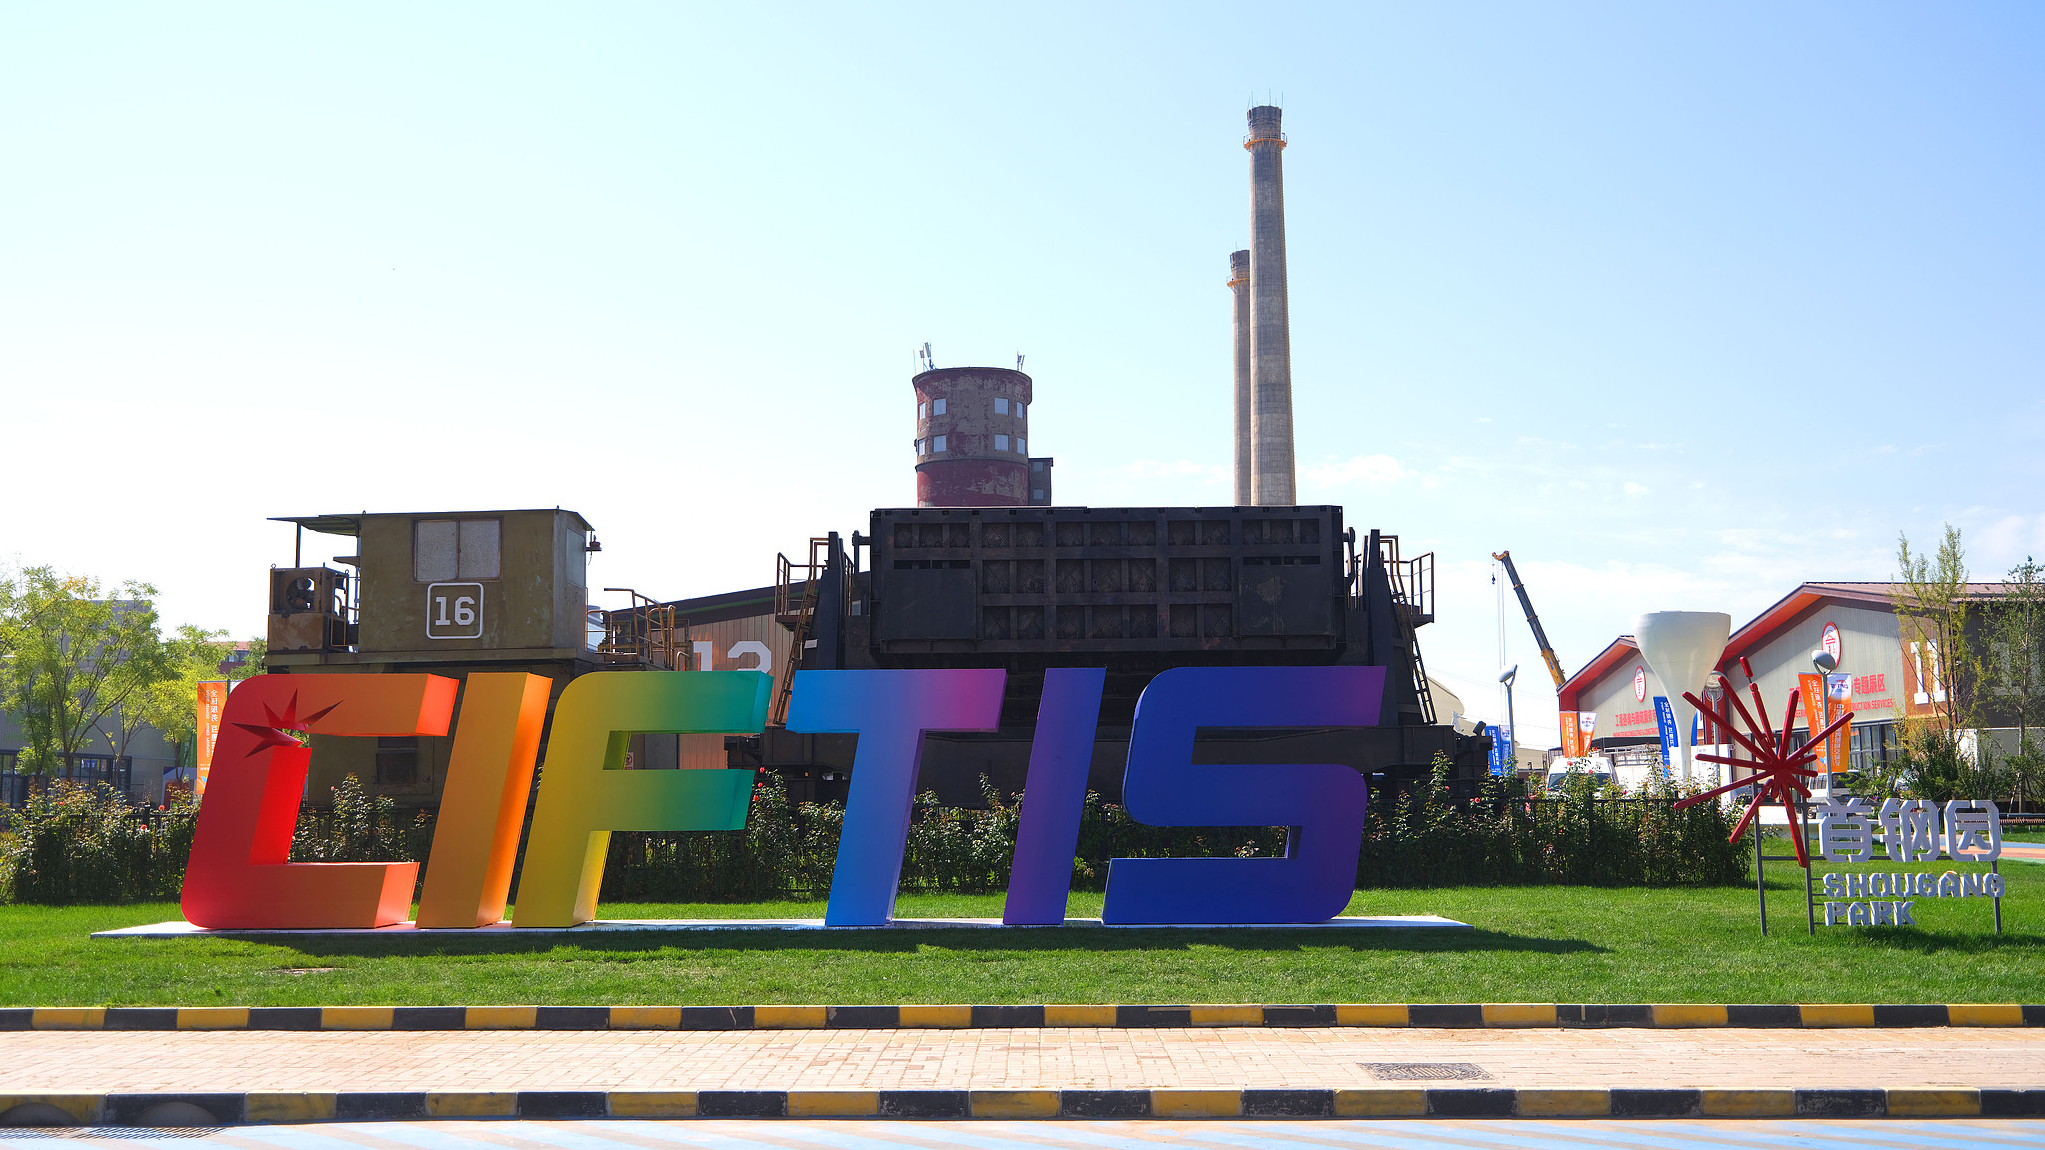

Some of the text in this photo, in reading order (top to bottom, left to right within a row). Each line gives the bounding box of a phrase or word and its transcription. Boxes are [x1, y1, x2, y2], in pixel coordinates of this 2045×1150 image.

[435, 596, 475, 626] 16
[180, 665, 1387, 930] CIFTIS
[1816, 797, 2002, 863] 首钢园
[1822, 871, 2006, 898] SHOUGANG
[1823, 901, 1916, 926] PARK
